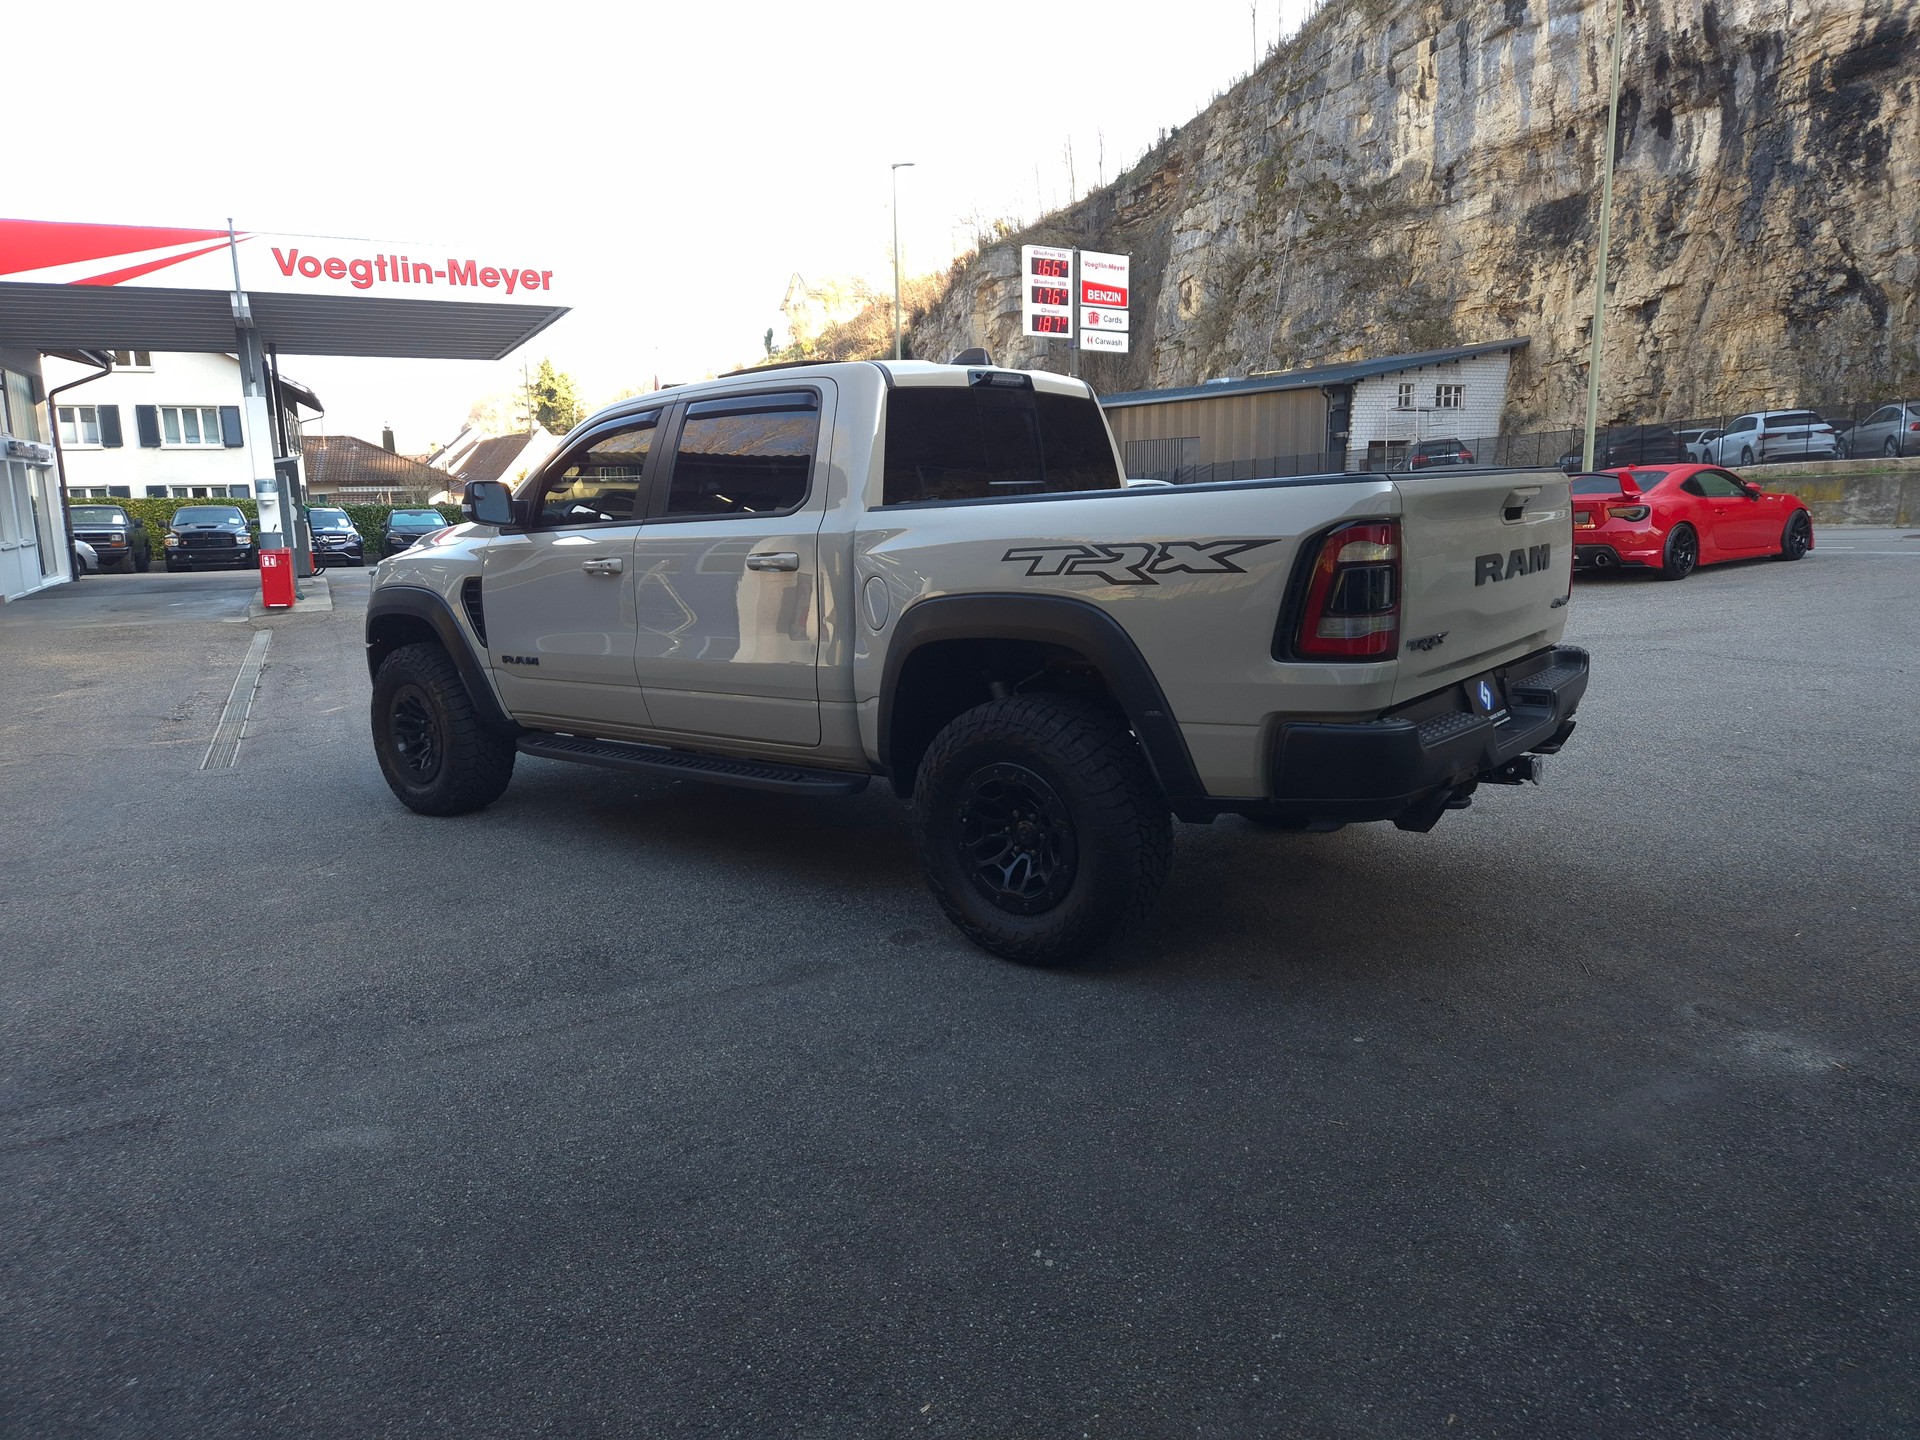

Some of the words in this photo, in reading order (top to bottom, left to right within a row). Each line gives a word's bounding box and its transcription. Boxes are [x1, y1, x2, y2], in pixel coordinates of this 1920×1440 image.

[1057, 251, 1067, 259] 95
[271, 247, 553, 294] Voegtlin-Meyer
[1084, 260, 1126, 271] Voegtlin-Meyer
[1087, 289, 1121, 303] BENZIN
[1103, 315, 1123, 324] Cards
[1095, 336, 1123, 347] Carwash
[1000, 538, 1282, 585] TRX
[1475, 543, 1551, 587] RAM
[501, 655, 540, 666] RAM
